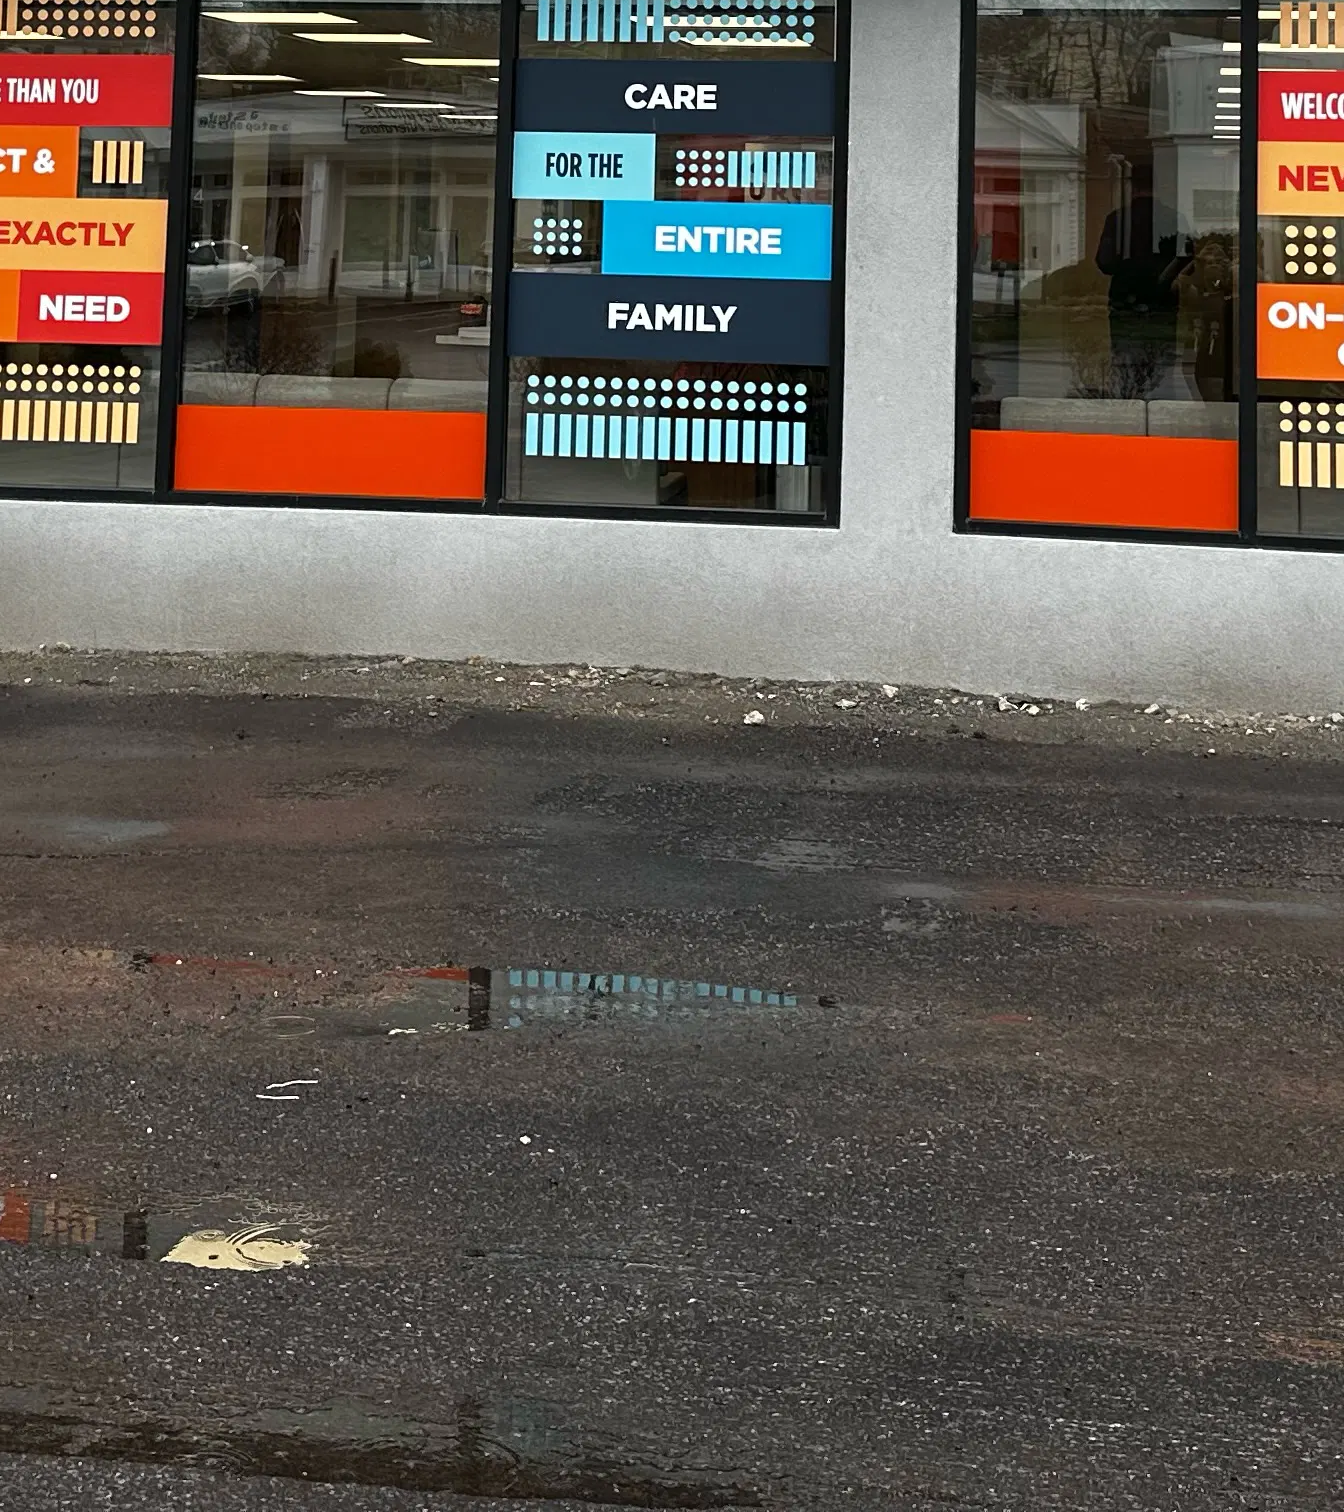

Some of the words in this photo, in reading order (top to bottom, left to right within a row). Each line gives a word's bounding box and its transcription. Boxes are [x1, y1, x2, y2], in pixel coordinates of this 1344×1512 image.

[7, 78, 56, 103] THAN
[60, 79, 99, 103] YOU
[624, 84, 718, 110] CARE
[33, 149, 55, 174] &
[545, 153, 582, 178] FOR
[587, 153, 624, 178] THE
[655, 226, 782, 254] ENTIRE
[39, 295, 130, 323] NEED
[608, 303, 737, 332] FAMILY
